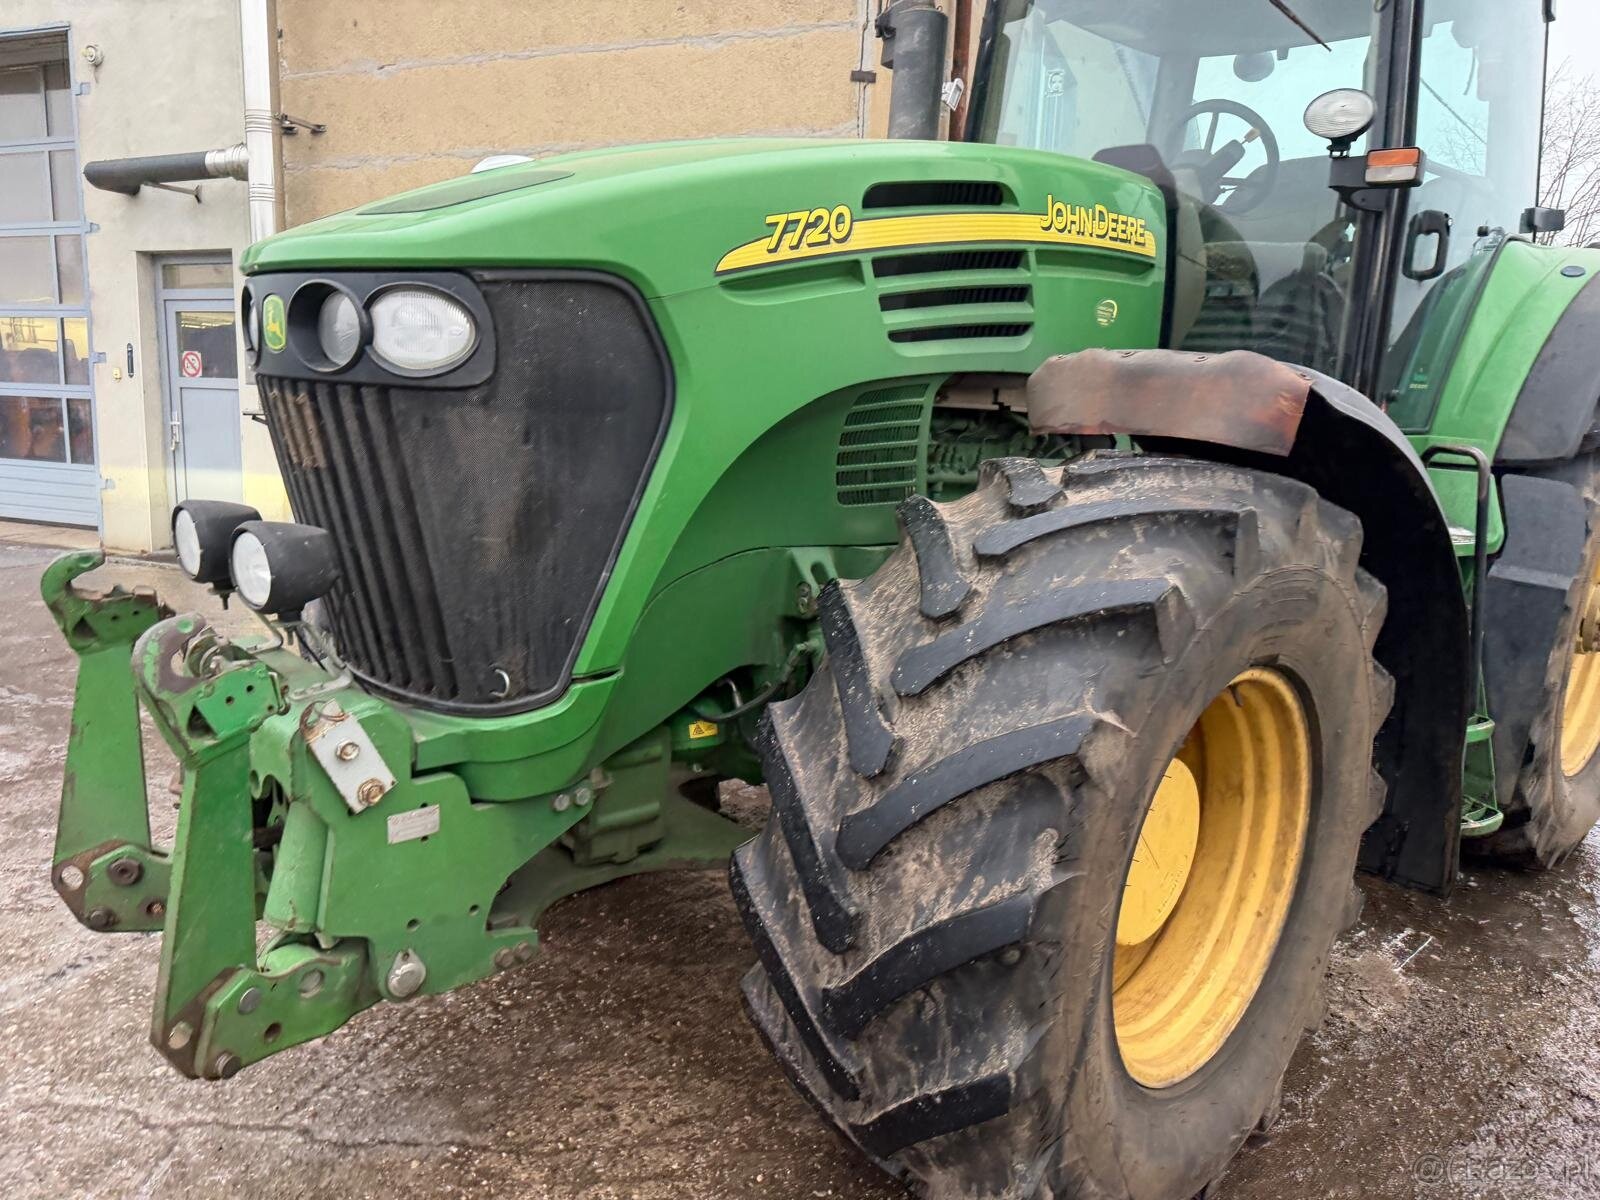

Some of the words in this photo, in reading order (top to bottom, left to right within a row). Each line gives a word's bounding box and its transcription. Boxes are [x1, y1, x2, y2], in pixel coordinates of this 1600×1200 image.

[765, 204, 852, 253] 7720
[1040, 194, 1093, 237] JOHN
[1095, 203, 1146, 246] DEERE
